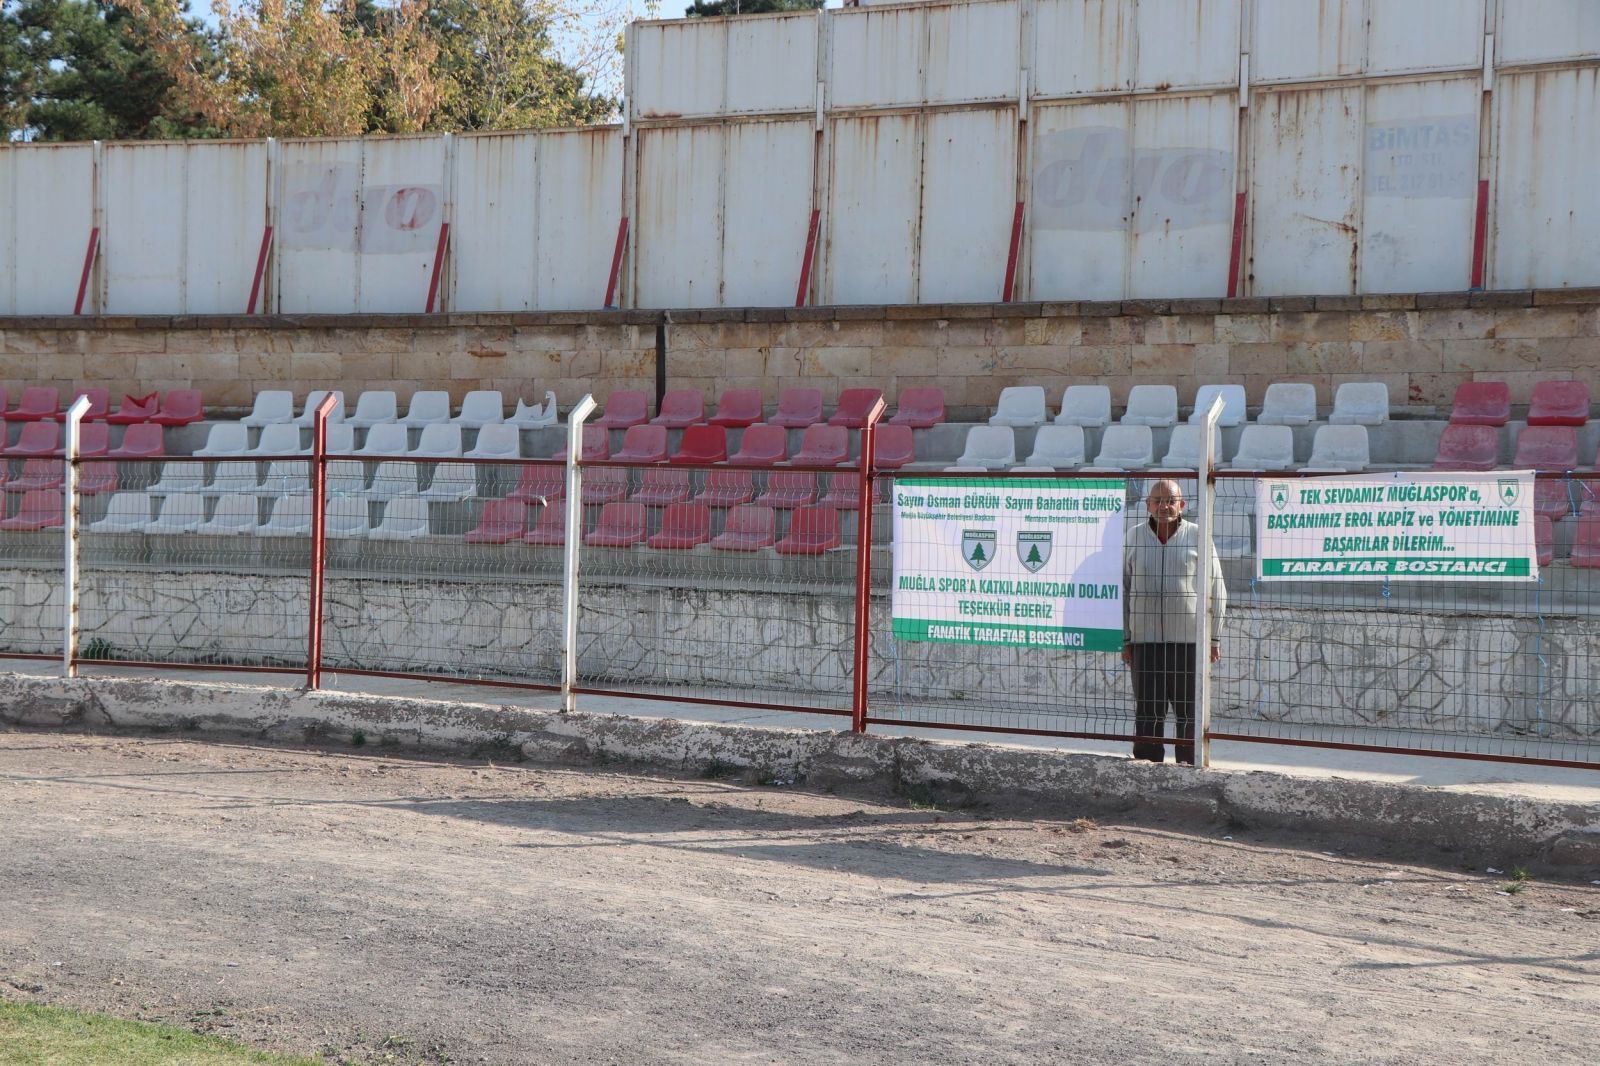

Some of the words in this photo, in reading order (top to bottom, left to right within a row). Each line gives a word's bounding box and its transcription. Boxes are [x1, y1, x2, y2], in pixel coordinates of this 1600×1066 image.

[897, 493, 925, 508] Sayın
[927, 494, 961, 508] Osman
[964, 492, 999, 509] GÜRÜN
[1005, 496, 1033, 511] Sayın
[1036, 496, 1079, 511] Bahattin
[1083, 494, 1122, 513] GÜMÜŞ
[1300, 489, 1322, 504] TEK
[1324, 487, 1385, 504] SEVDAMIZ
[1387, 482, 1482, 504] MUĞLASPOR'a,
[1267, 512, 1342, 533] BAŞKANIMIZ
[1344, 511, 1373, 528] EROL
[1418, 515, 1434, 526] ve
[1438, 506, 1520, 527] YÖNETİMİNE
[1322, 536, 1390, 557] BAŞARILAR
[1392, 531, 1455, 552] DİLERİM...
[1281, 561, 1389, 573] TARAFTAR
[1394, 560, 1507, 573] BOSTANCI
[899, 574, 936, 591] MUĞLA
[939, 578, 976, 592] SPOR'A
[980, 579, 1075, 598] KATKILARINIZDAN
[1079, 583, 1119, 600] DOLAYI
[958, 599, 1010, 616] TEŞEKKÜR
[1014, 601, 1053, 619] EDERİZ
[927, 624, 971, 640] FANATİK
[973, 627, 1026, 643] TARAFTAR
[1029, 630, 1085, 647] BOSTANCI
